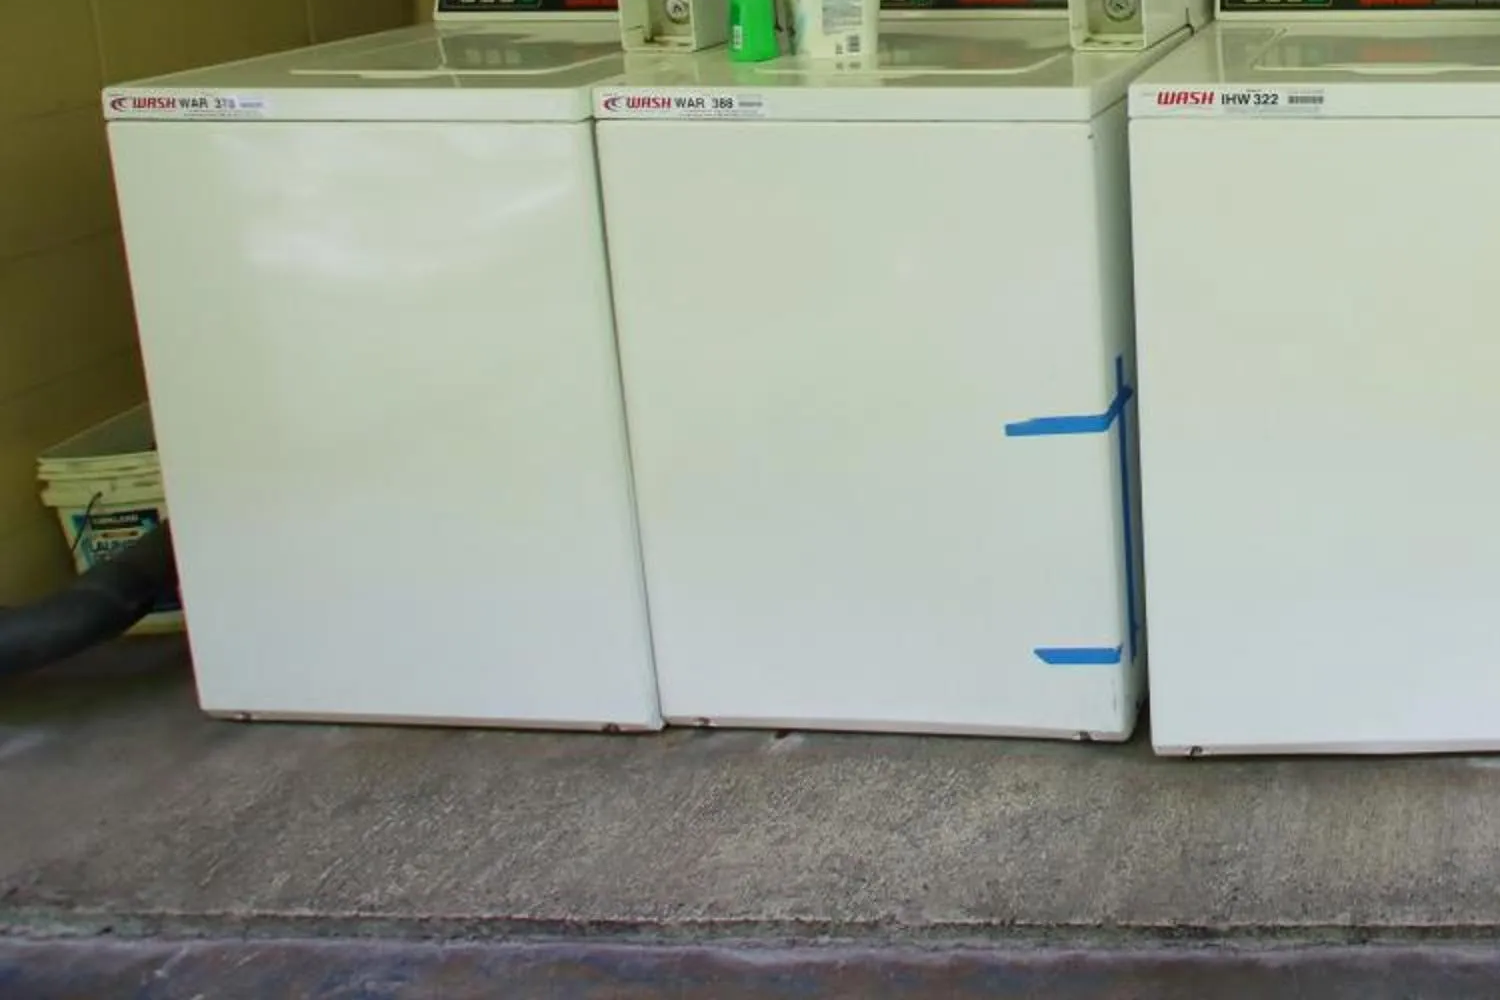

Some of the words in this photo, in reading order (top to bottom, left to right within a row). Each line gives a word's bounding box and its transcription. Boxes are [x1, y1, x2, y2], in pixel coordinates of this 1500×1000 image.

[179, 97, 209, 109] WAR
[674, 97, 705, 109] WAR
[1157, 90, 1214, 105] WASH
[1221, 93, 1251, 105] IHW
[1253, 93, 1280, 105] 322
